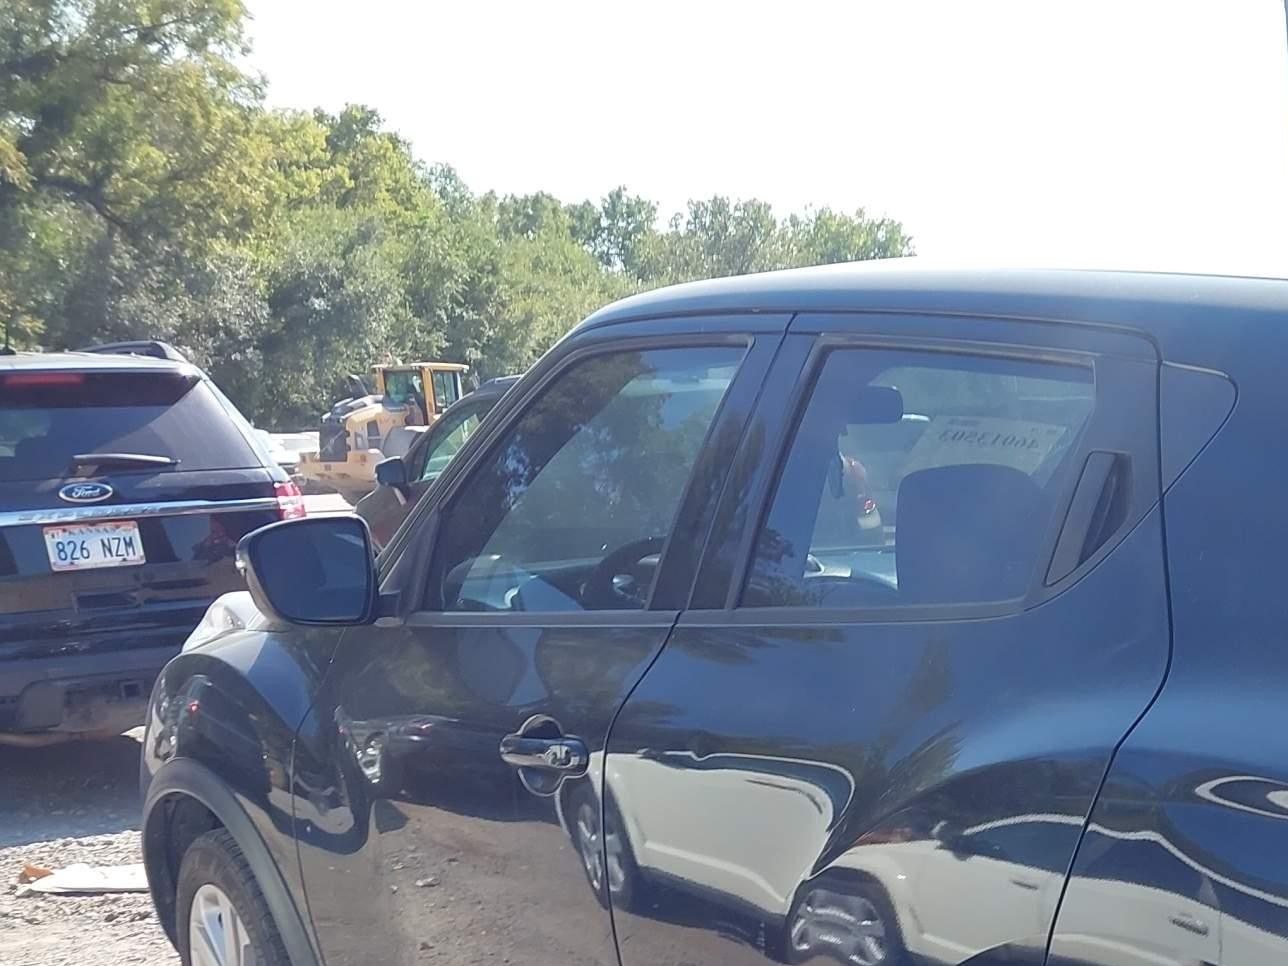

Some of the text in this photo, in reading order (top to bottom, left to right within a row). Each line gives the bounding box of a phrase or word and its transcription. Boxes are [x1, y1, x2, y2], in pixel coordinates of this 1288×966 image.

[72, 485, 100, 498] Ford
[56, 536, 136, 561] 826 NZM
